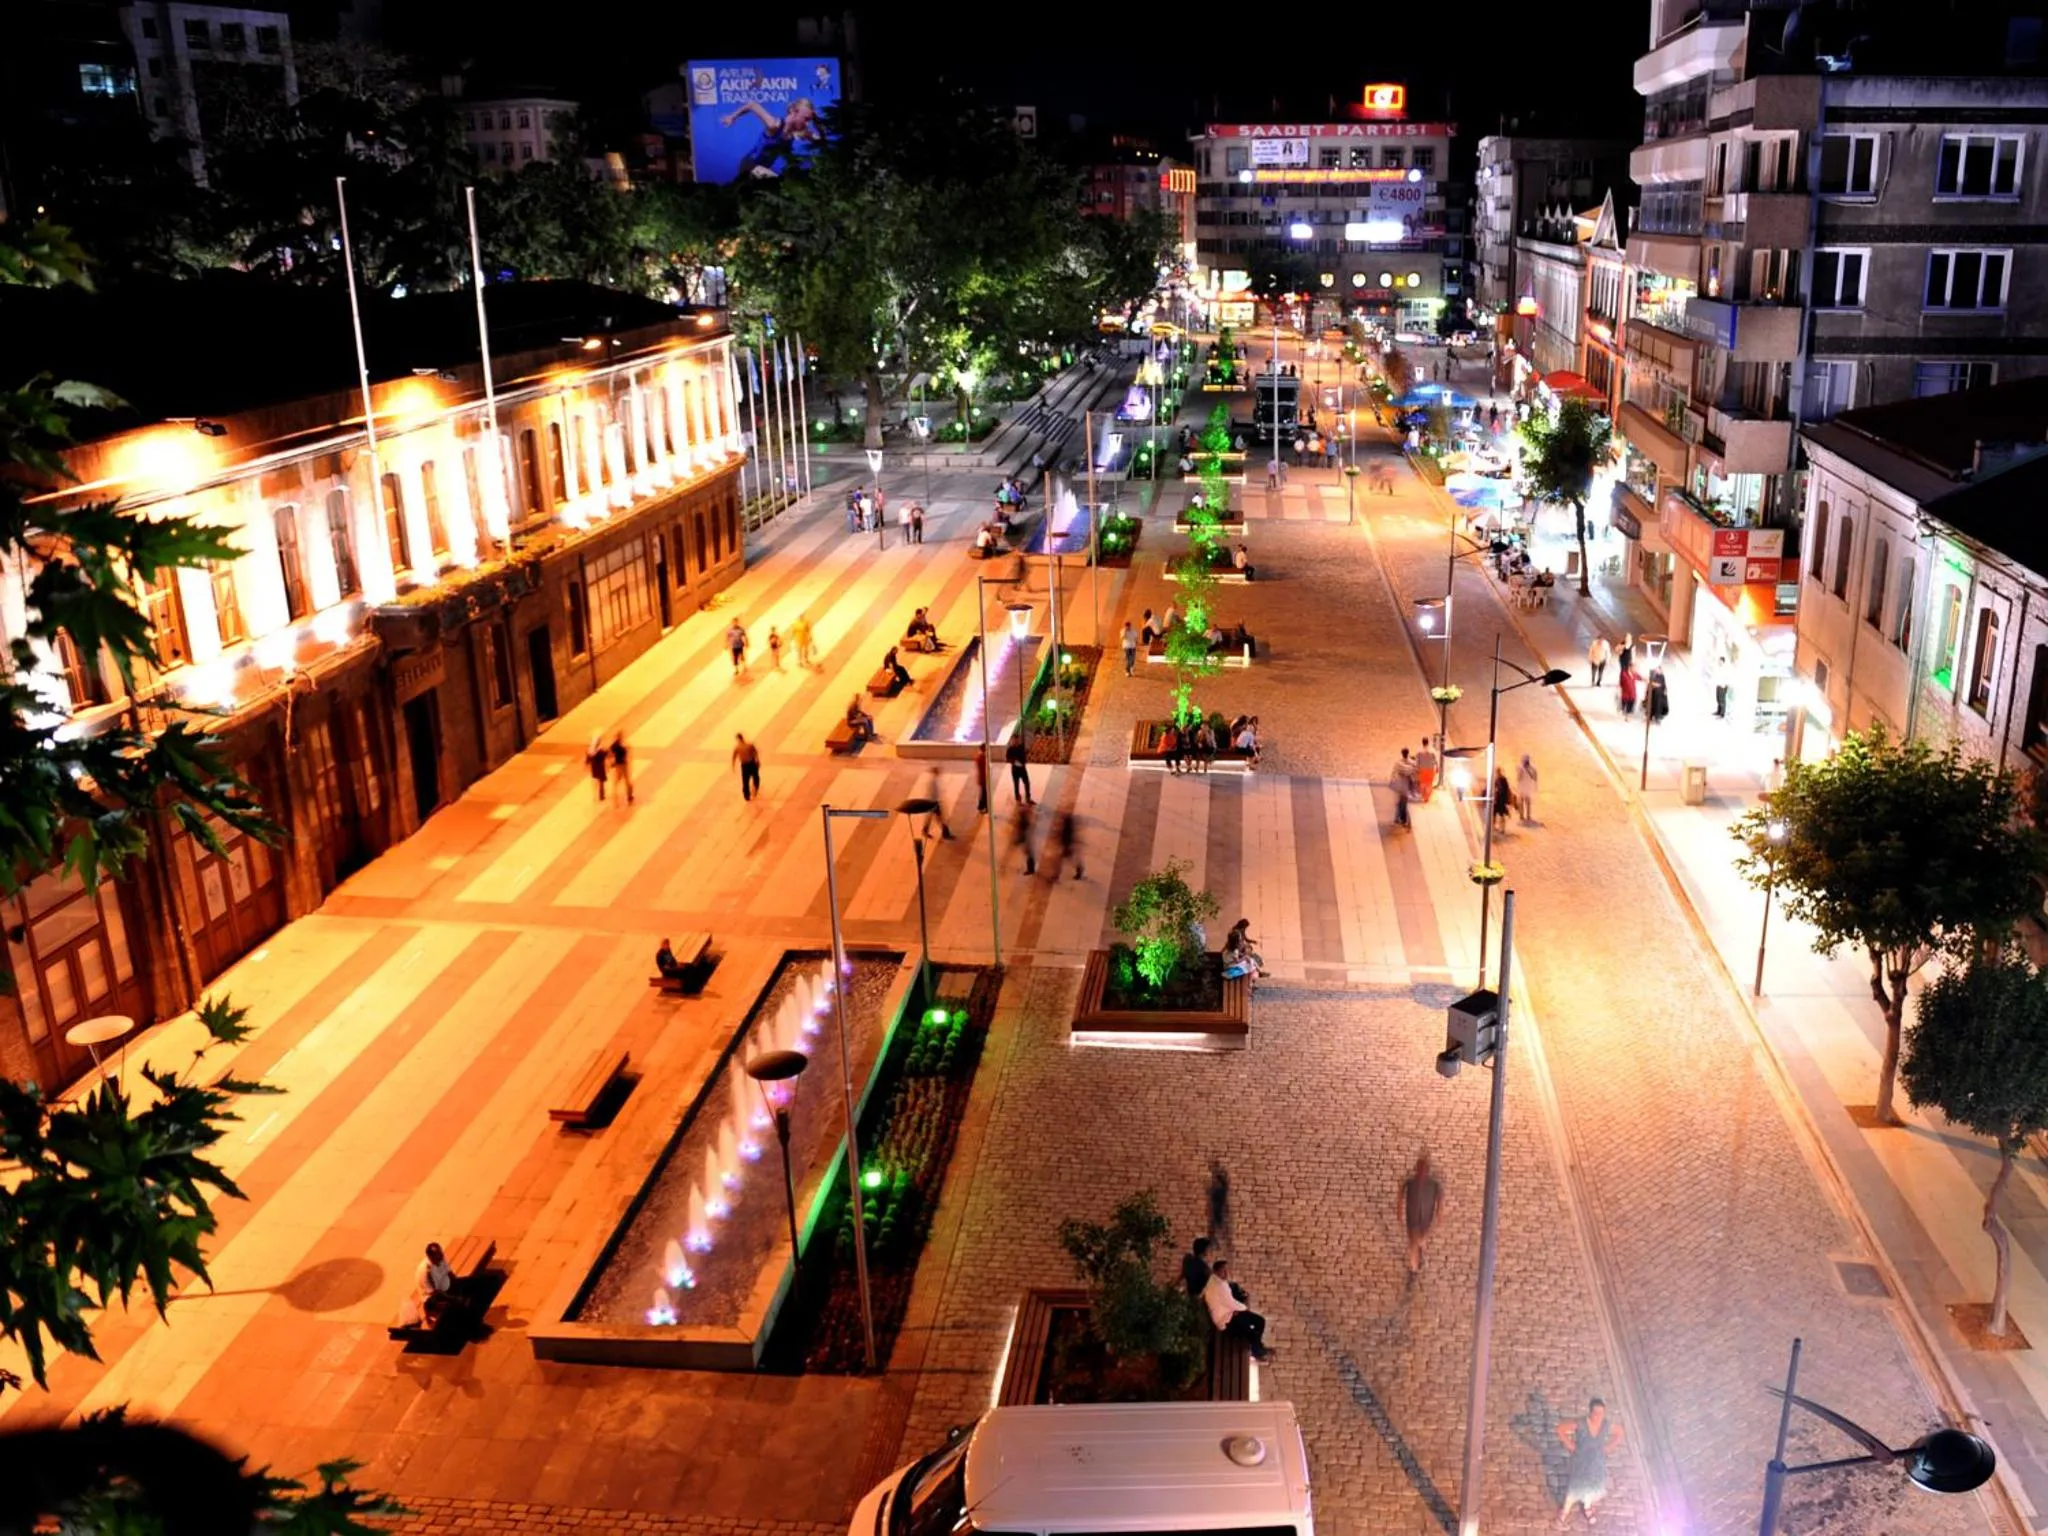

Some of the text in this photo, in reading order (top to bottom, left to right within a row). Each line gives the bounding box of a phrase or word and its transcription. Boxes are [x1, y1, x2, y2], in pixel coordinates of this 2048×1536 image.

[761, 77, 797, 90] AKIN
[1238, 124, 1325, 136] SAADET
[1379, 187, 1421, 201] €4800
